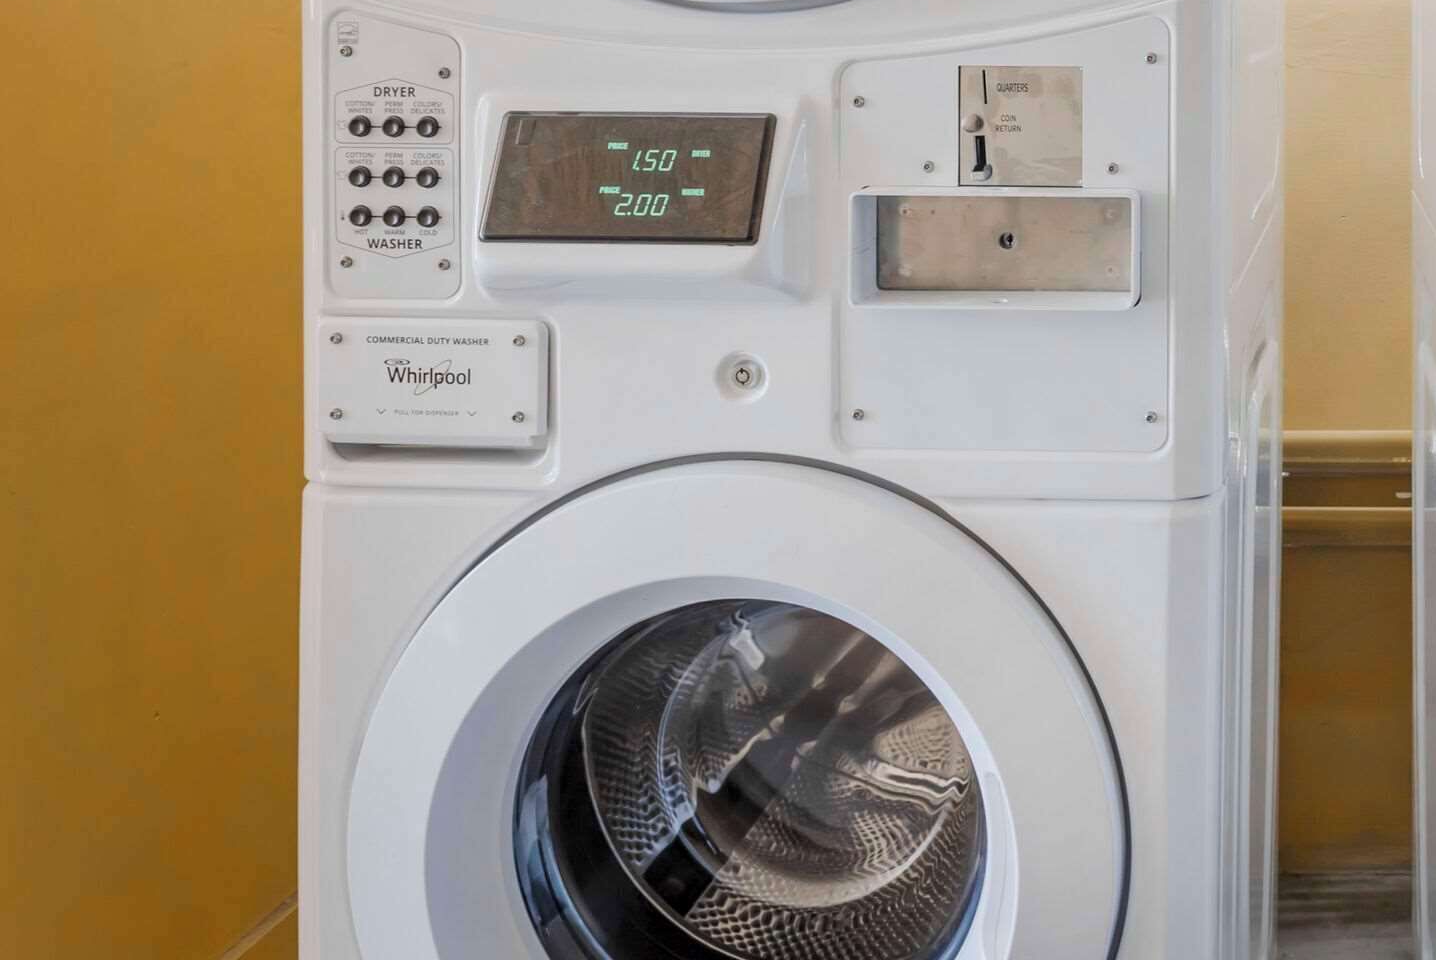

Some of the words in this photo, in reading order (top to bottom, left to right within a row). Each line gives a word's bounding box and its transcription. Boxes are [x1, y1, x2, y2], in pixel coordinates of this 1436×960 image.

[373, 86, 416, 97] DRYER
[996, 83, 1029, 92] QUARTERS
[632, 150, 677, 171] 1.50
[614, 194, 670, 216] 2.00
[367, 239, 423, 249] WASHER
[366, 336, 425, 344] COMMERCIAL
[386, 367, 471, 390] Whirlpool
